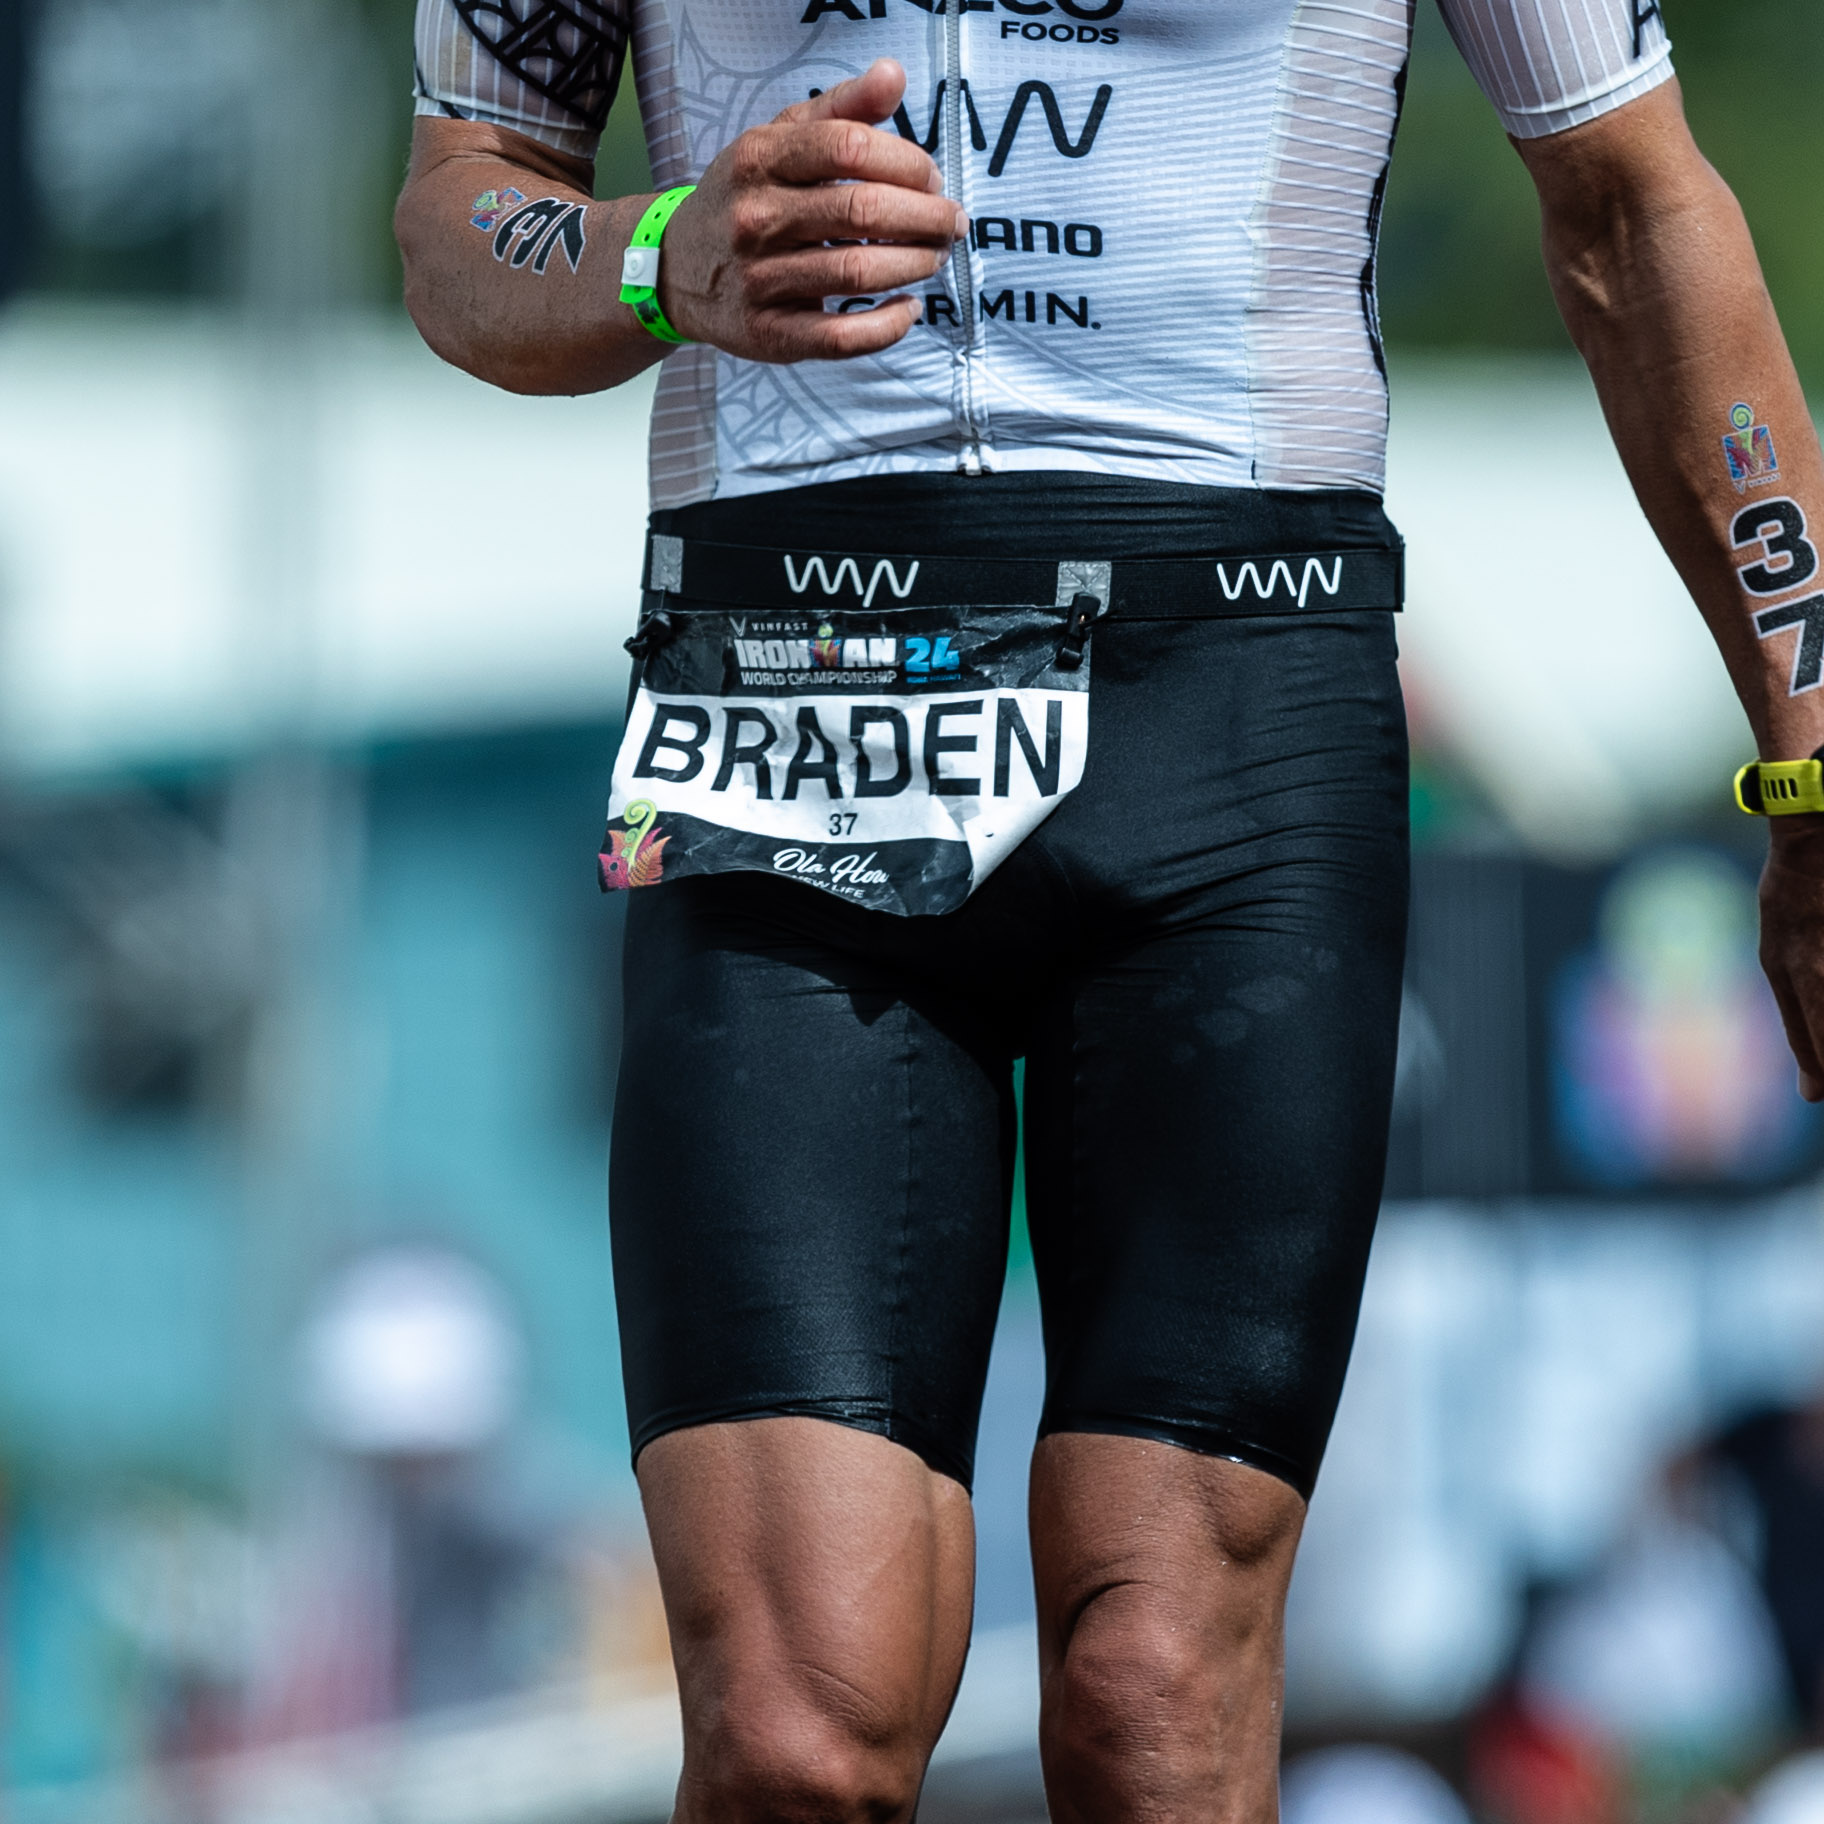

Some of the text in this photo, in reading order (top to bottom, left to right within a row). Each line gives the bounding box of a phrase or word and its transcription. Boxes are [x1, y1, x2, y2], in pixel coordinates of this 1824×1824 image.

[1000, 21, 1120, 45] FOODS
[905, 636, 960, 673] 24
[740, 671, 787, 686] WORLD
[787, 670, 898, 685] CHAMPIONSHIP
[633, 697, 1063, 802] BRADEN
[829, 812, 858, 836] 37
[773, 848, 826, 873] Ola
[831, 884, 866, 898] LIFE
